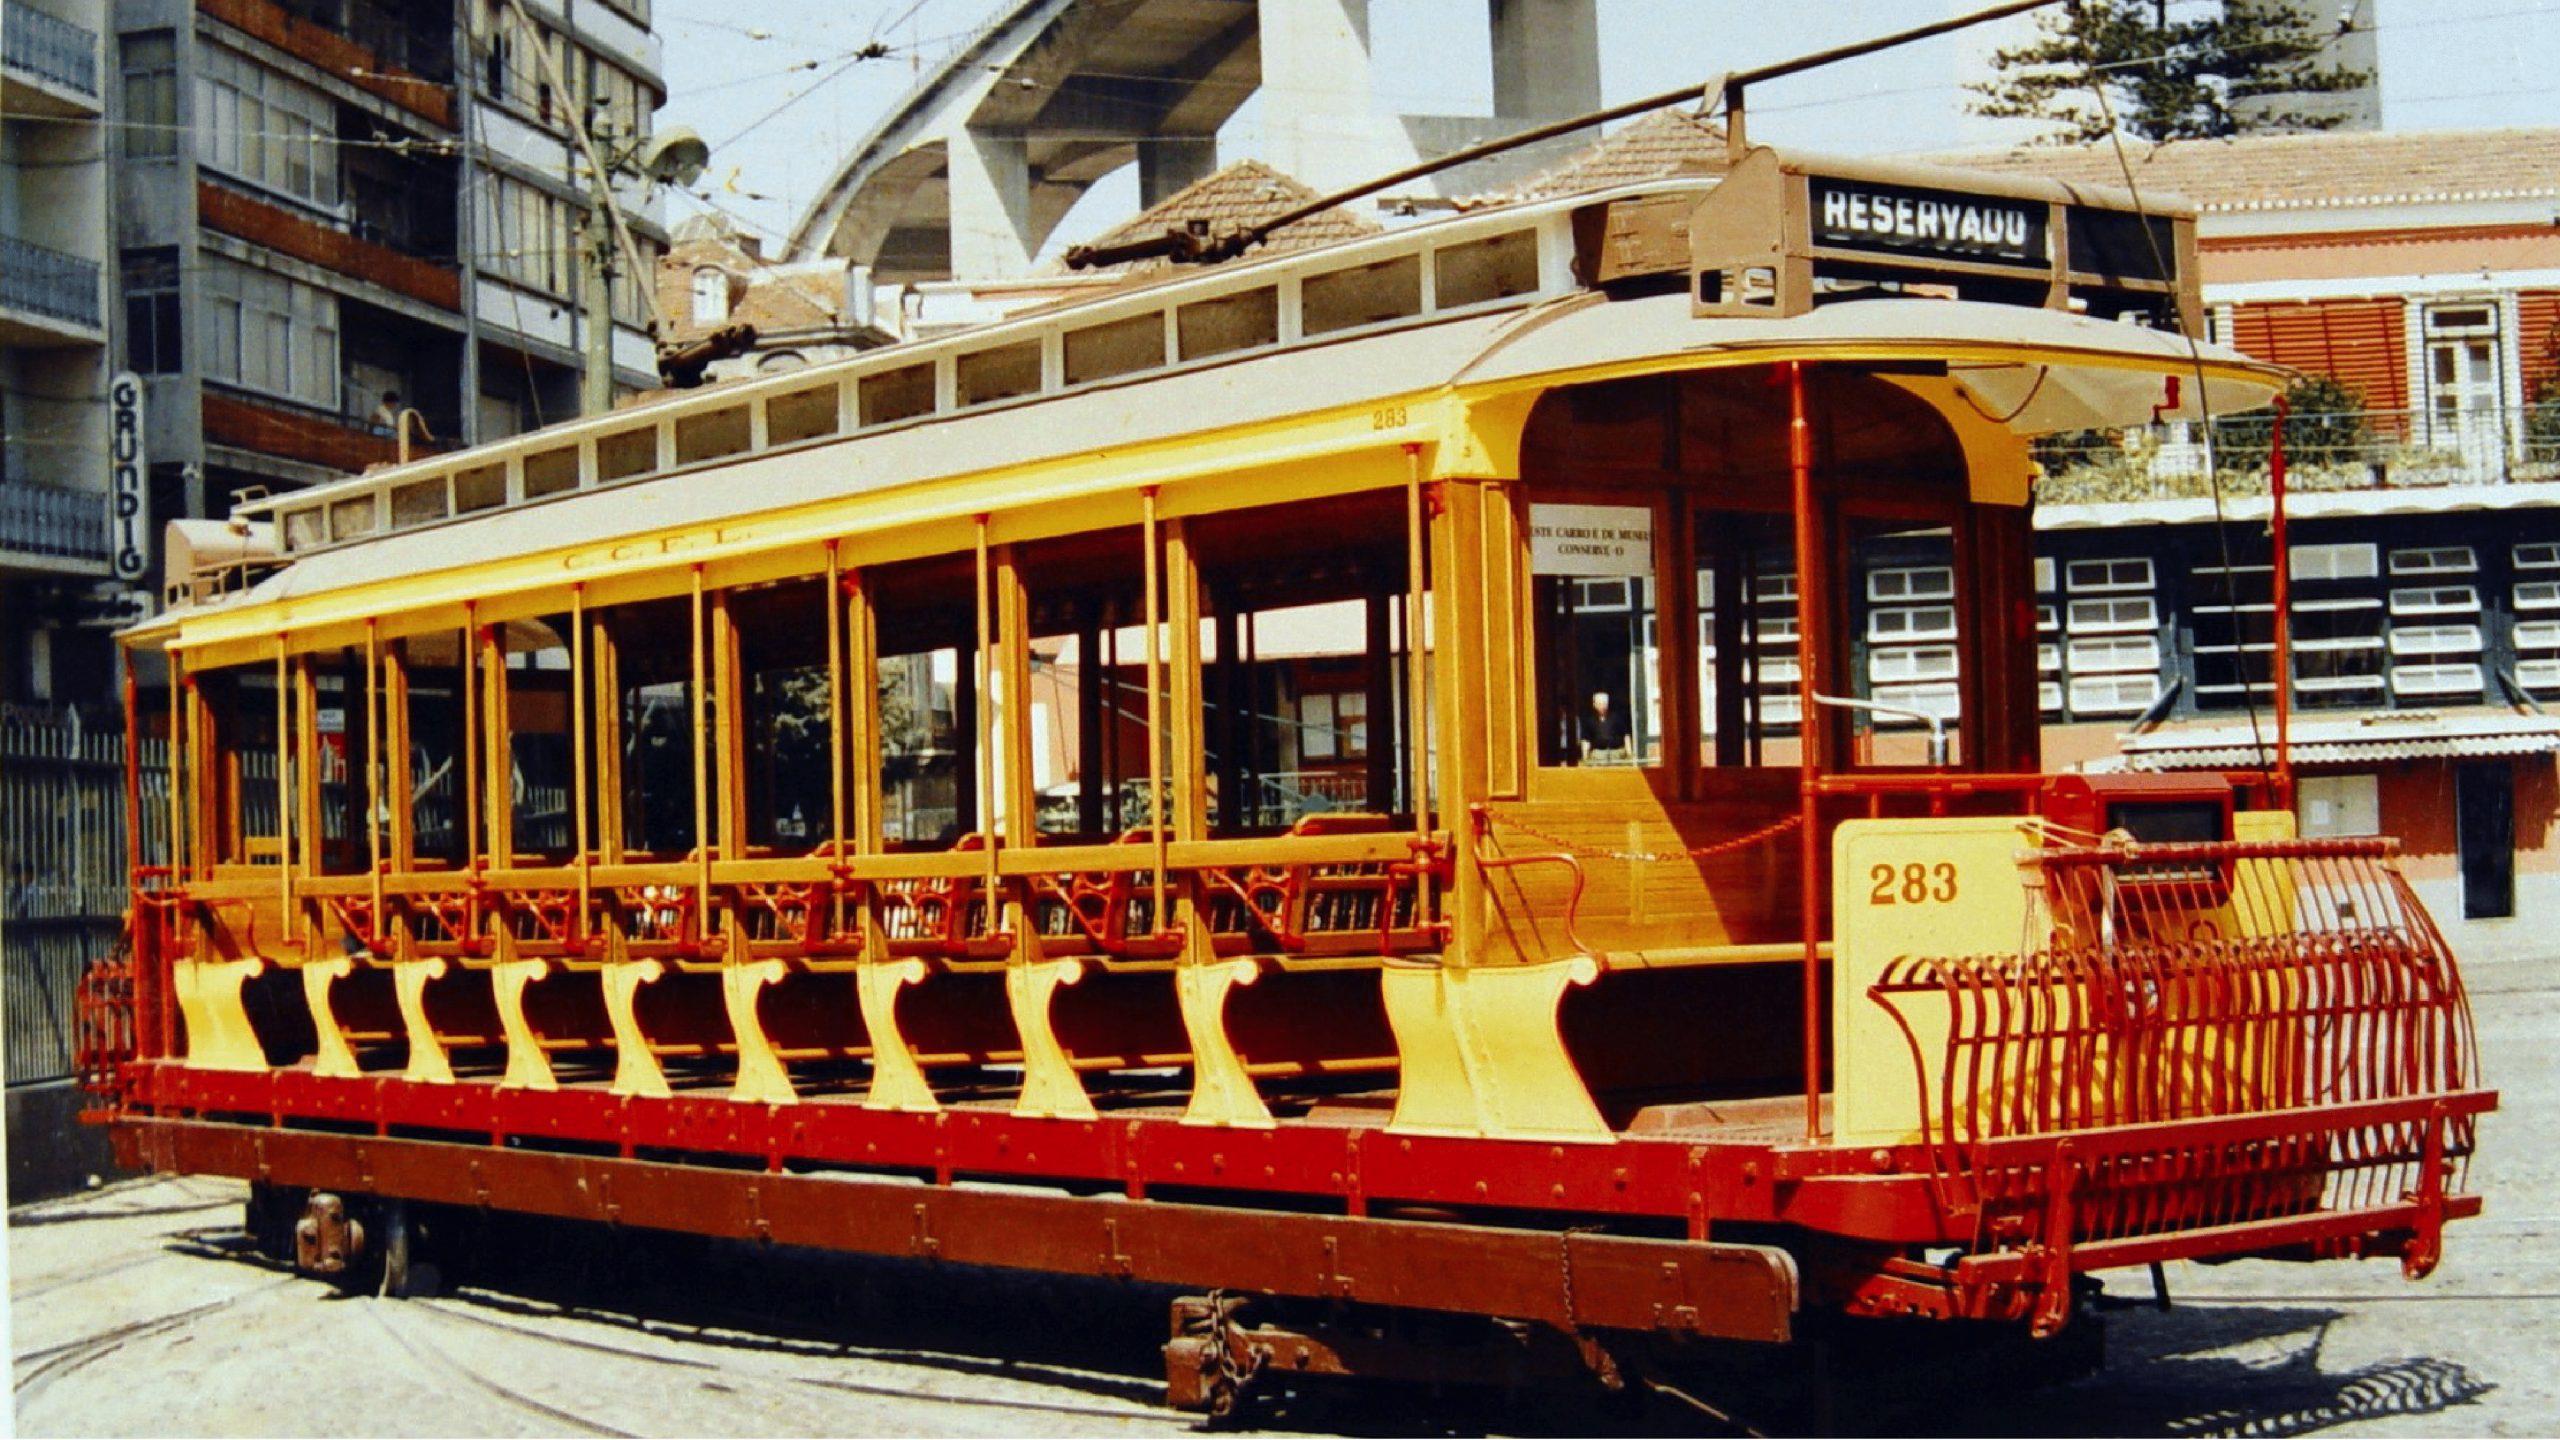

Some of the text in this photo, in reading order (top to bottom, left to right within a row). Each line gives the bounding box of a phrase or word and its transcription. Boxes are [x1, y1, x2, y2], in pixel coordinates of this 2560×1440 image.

[1823, 190, 2026, 247] RESERVADO
[1373, 406, 1407, 431] 283
[113, 381, 142, 573] GRUNDIG
[1869, 861, 1958, 906] 283
